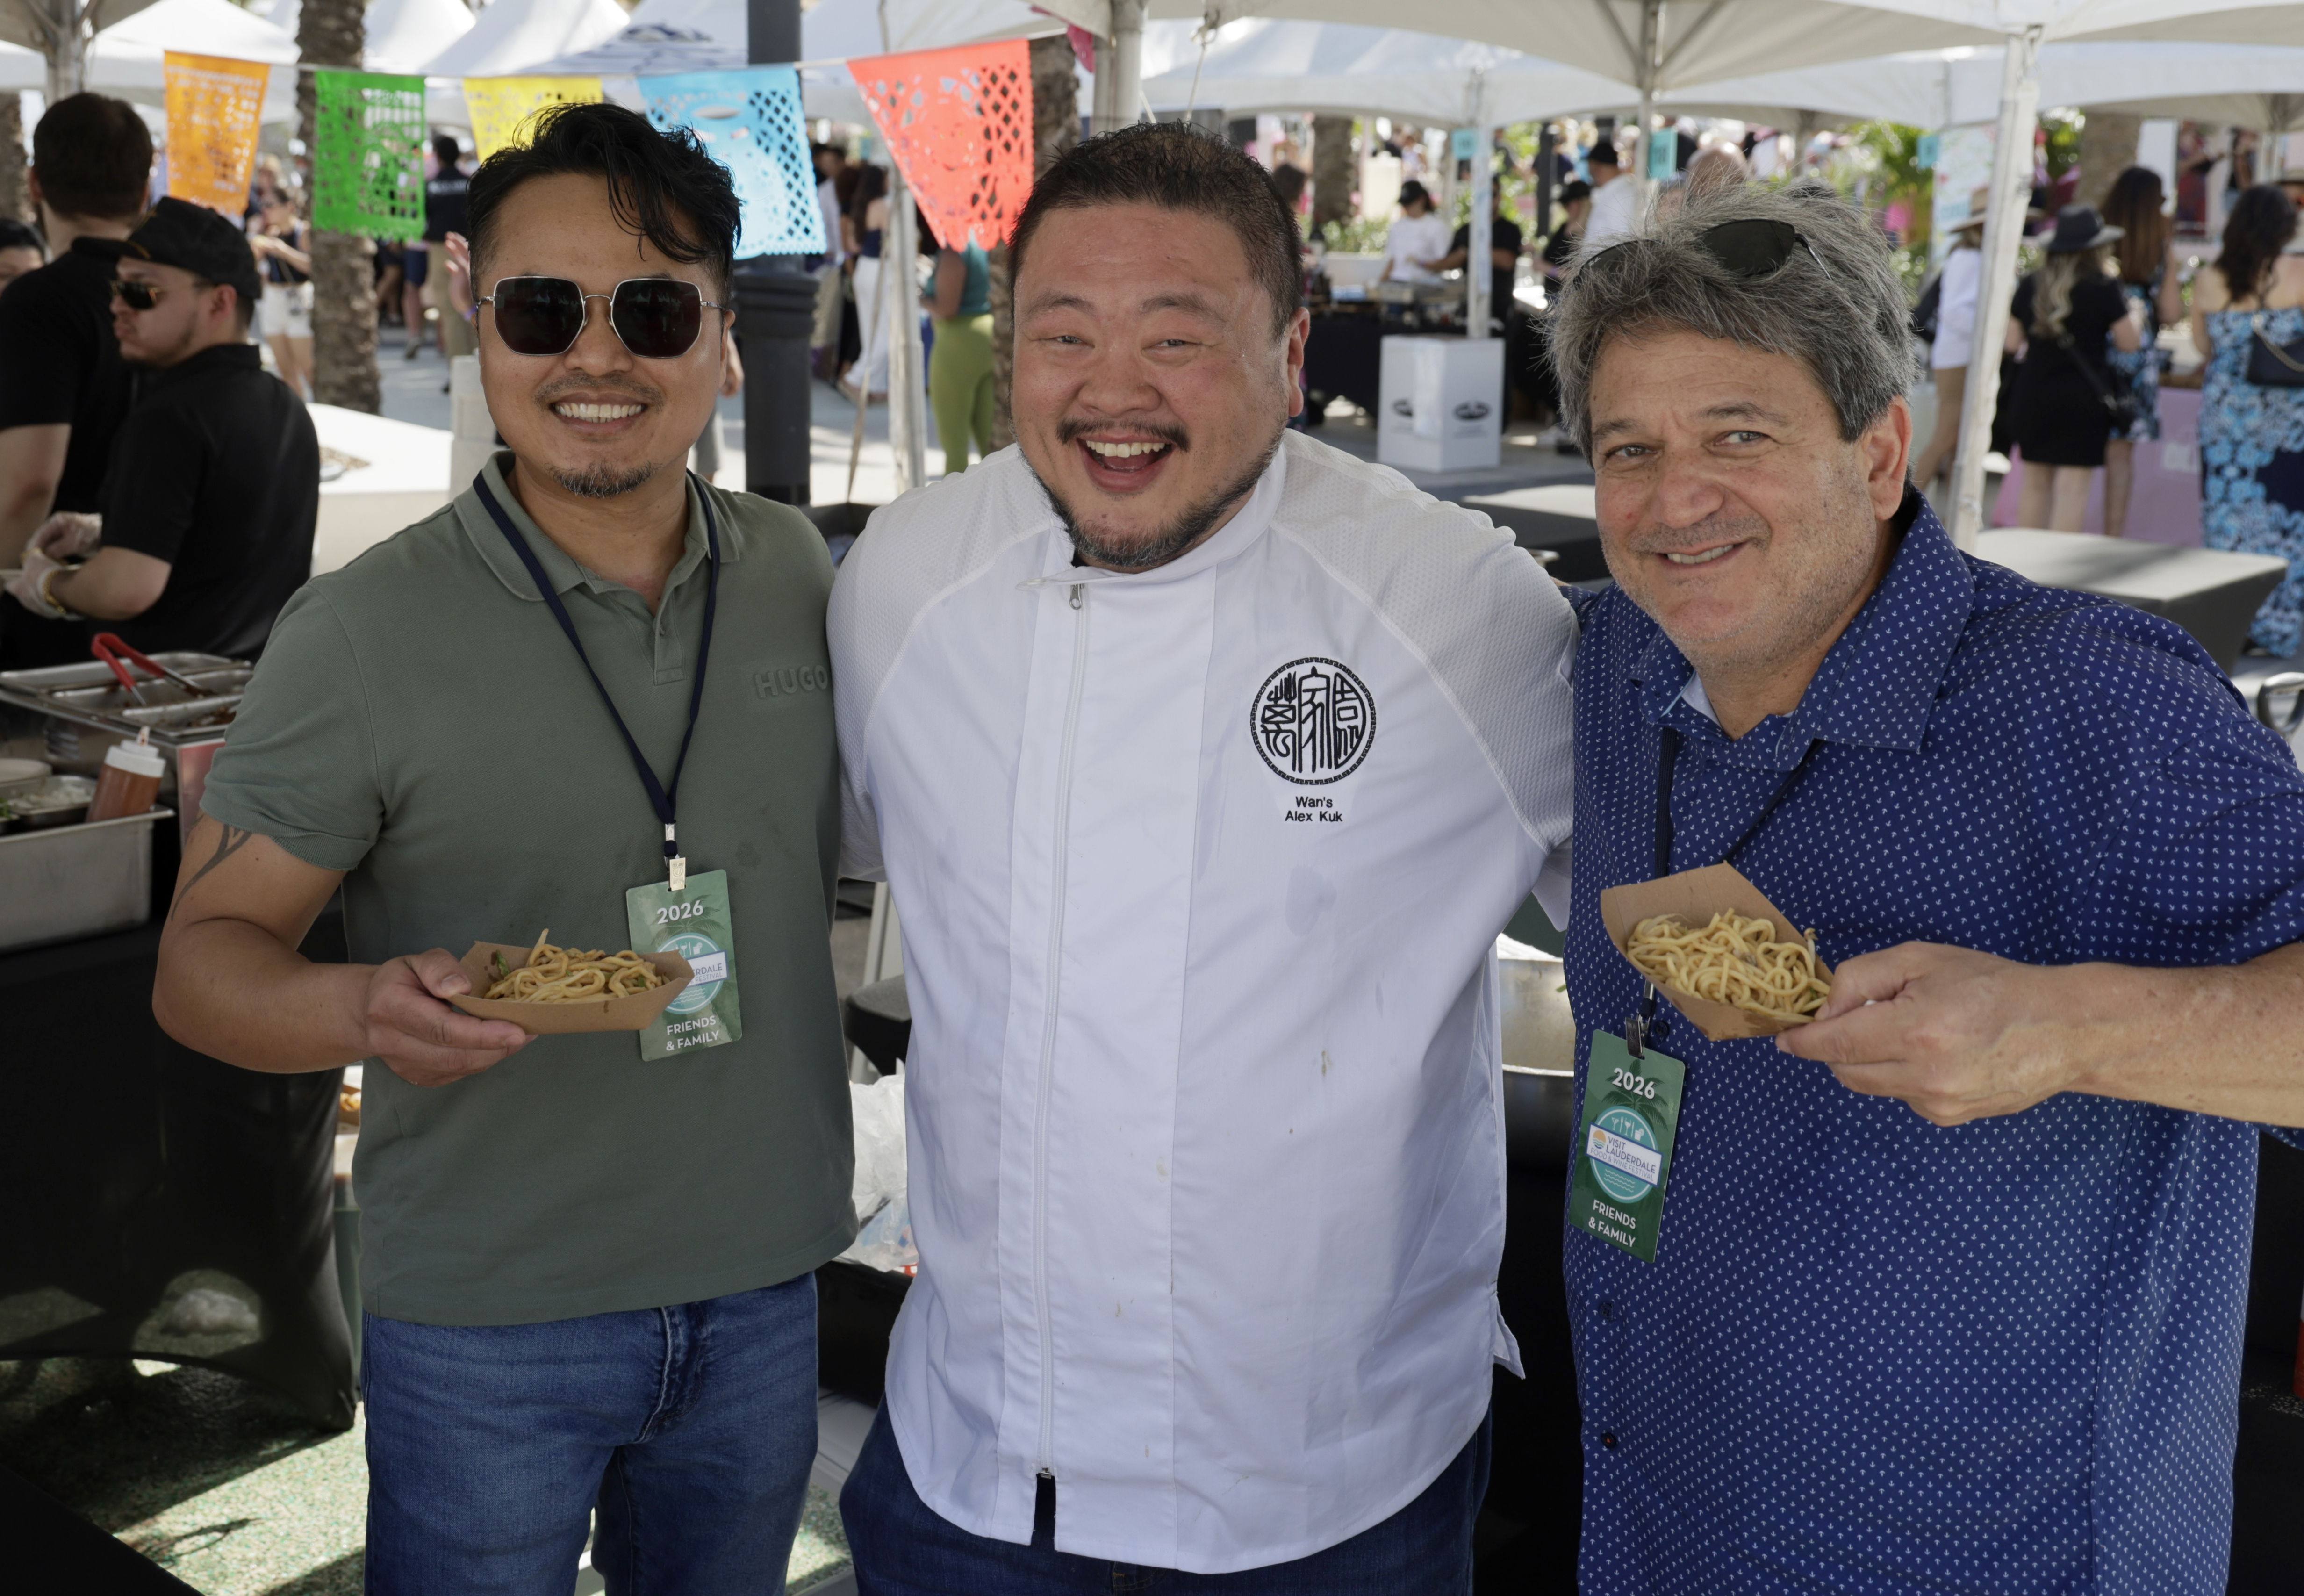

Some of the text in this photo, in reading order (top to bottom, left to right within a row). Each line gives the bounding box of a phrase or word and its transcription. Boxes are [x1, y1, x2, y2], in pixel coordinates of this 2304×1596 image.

[754, 665, 828, 698] HUGO
[1295, 796, 1333, 808] Wan's
[1285, 810, 1343, 822] Alex Kuk
[657, 900, 704, 925] 2026
[692, 963, 723, 976] RDALE
[695, 971, 723, 983] FESTIVAL
[667, 1015, 716, 1035] FRIENDS
[666, 1030, 720, 1051] & FAMILY
[1612, 1067, 1655, 1100] 2026
[1608, 1136, 1626, 1150] VISIT
[1590, 1147, 1607, 1160] FOOD
[1613, 1157, 1628, 1170] WINE
[1628, 1164, 1654, 1181] FESTIVAL
[1606, 1144, 1656, 1174] LAUDERDALE
[1593, 1198, 1636, 1229] FRIENDS
[1588, 1216, 1636, 1248] & FAMILY
